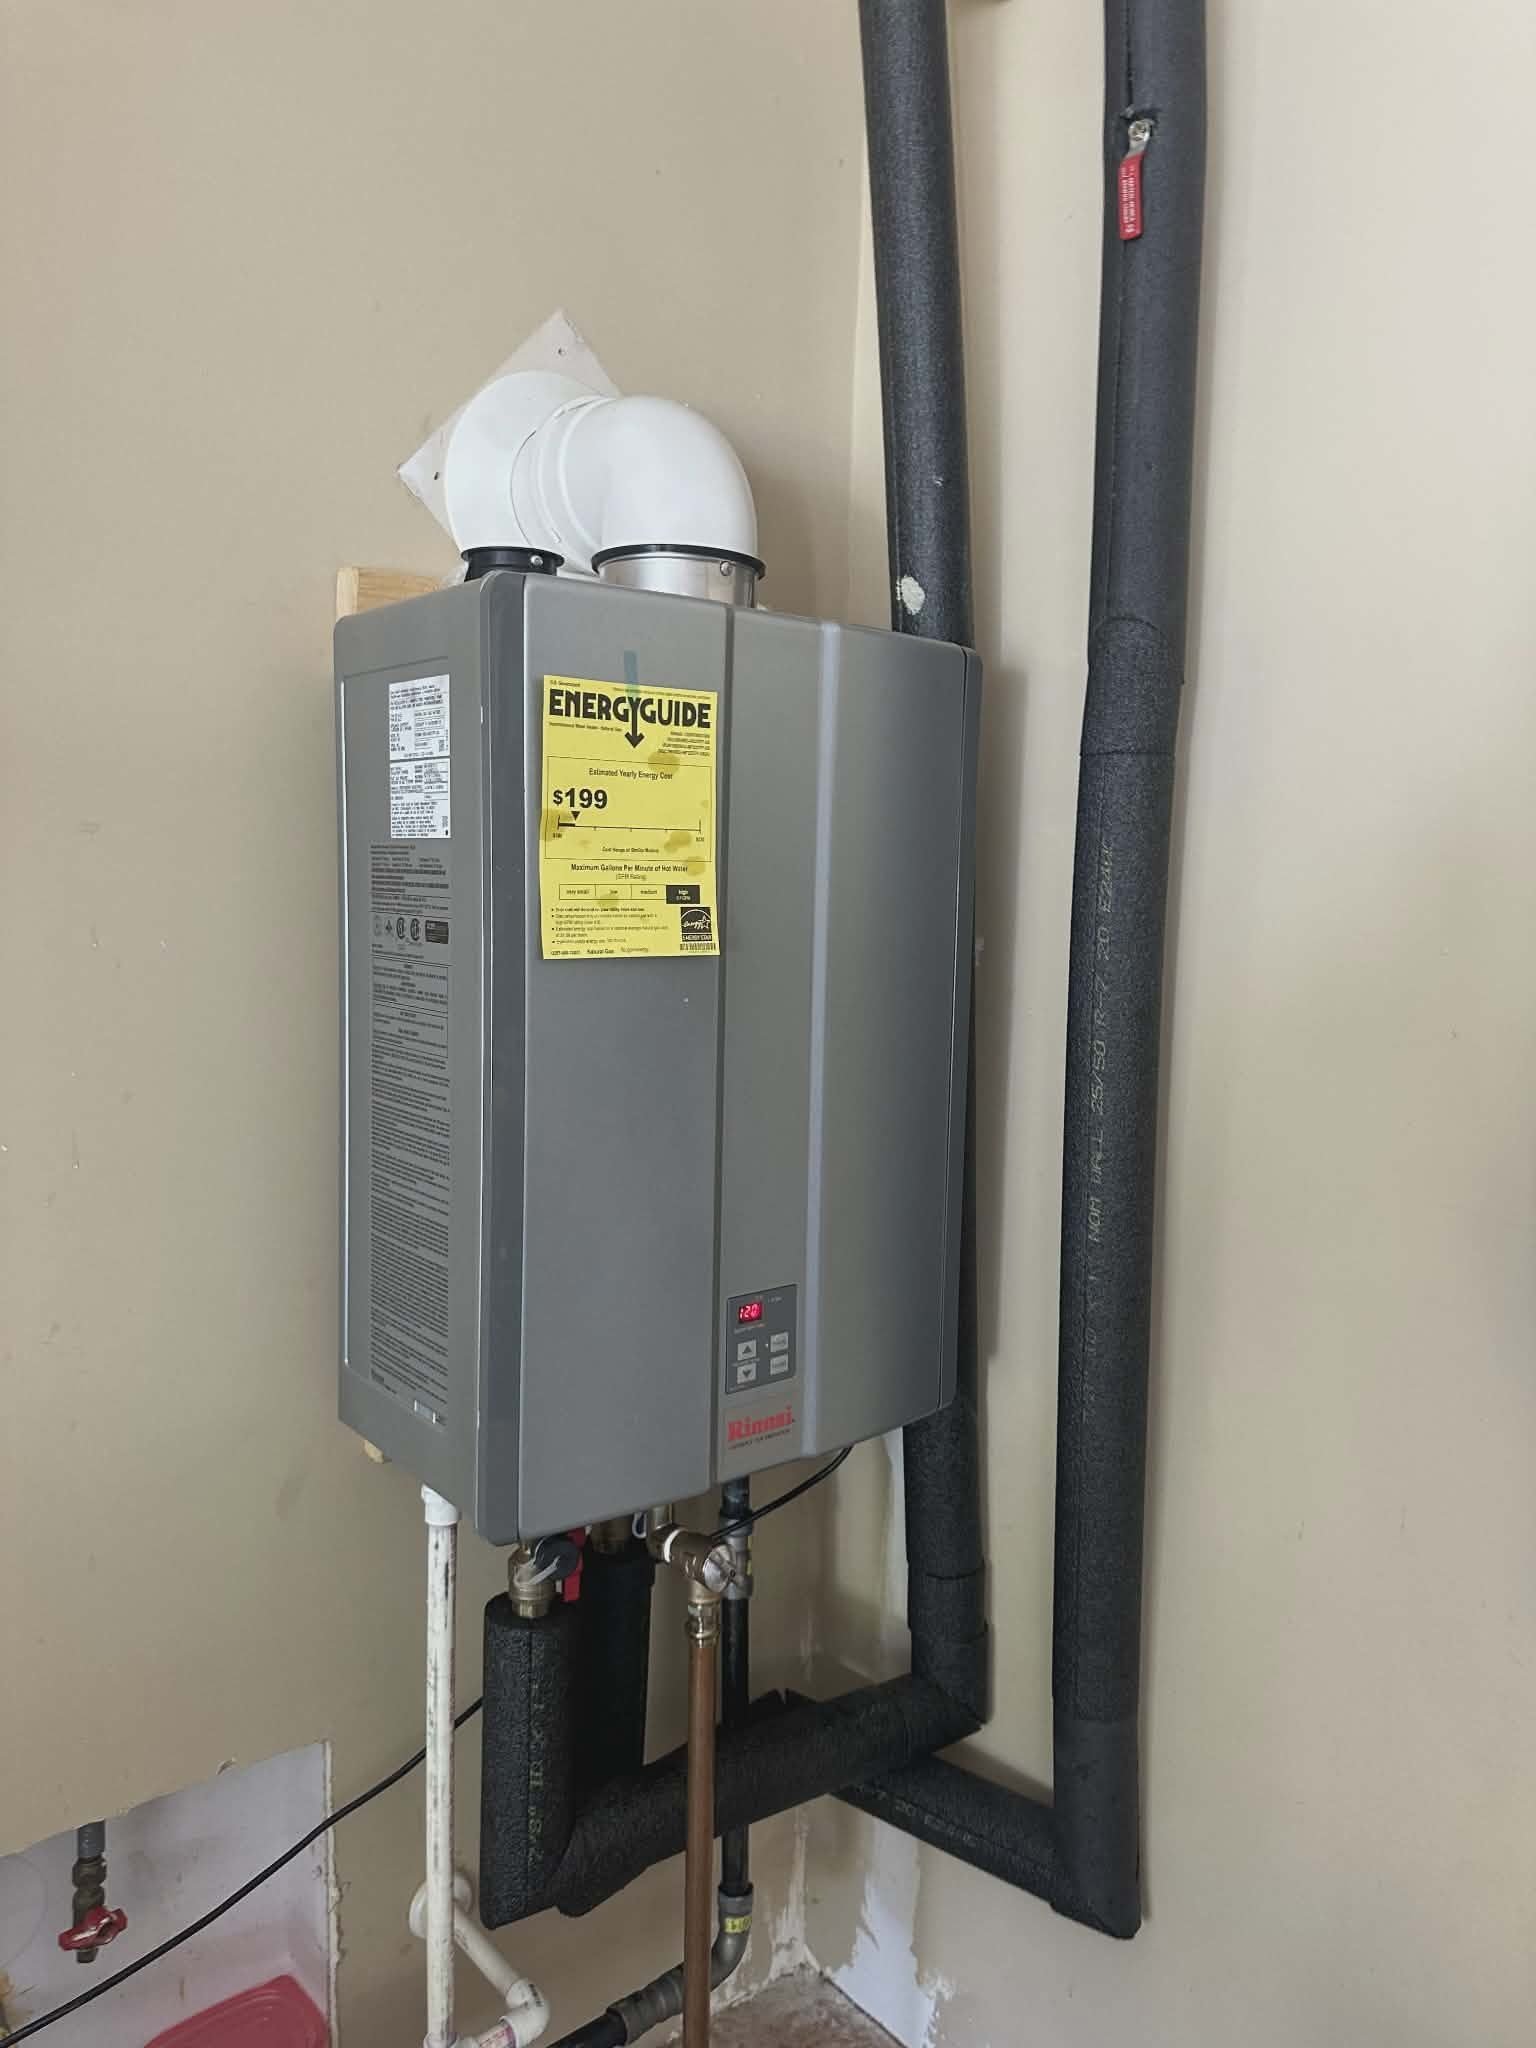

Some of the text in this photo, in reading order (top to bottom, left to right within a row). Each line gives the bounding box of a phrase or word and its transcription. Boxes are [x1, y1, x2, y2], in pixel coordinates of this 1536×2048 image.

[549, 688, 711, 729] ENERGYGUIDE
[589, 768, 618, 777] Estimated
[619, 769, 637, 779] Yearly
[638, 770, 659, 781] Energy
[553, 787, 608, 809] $199
[739, 1303, 761, 1320] 120
